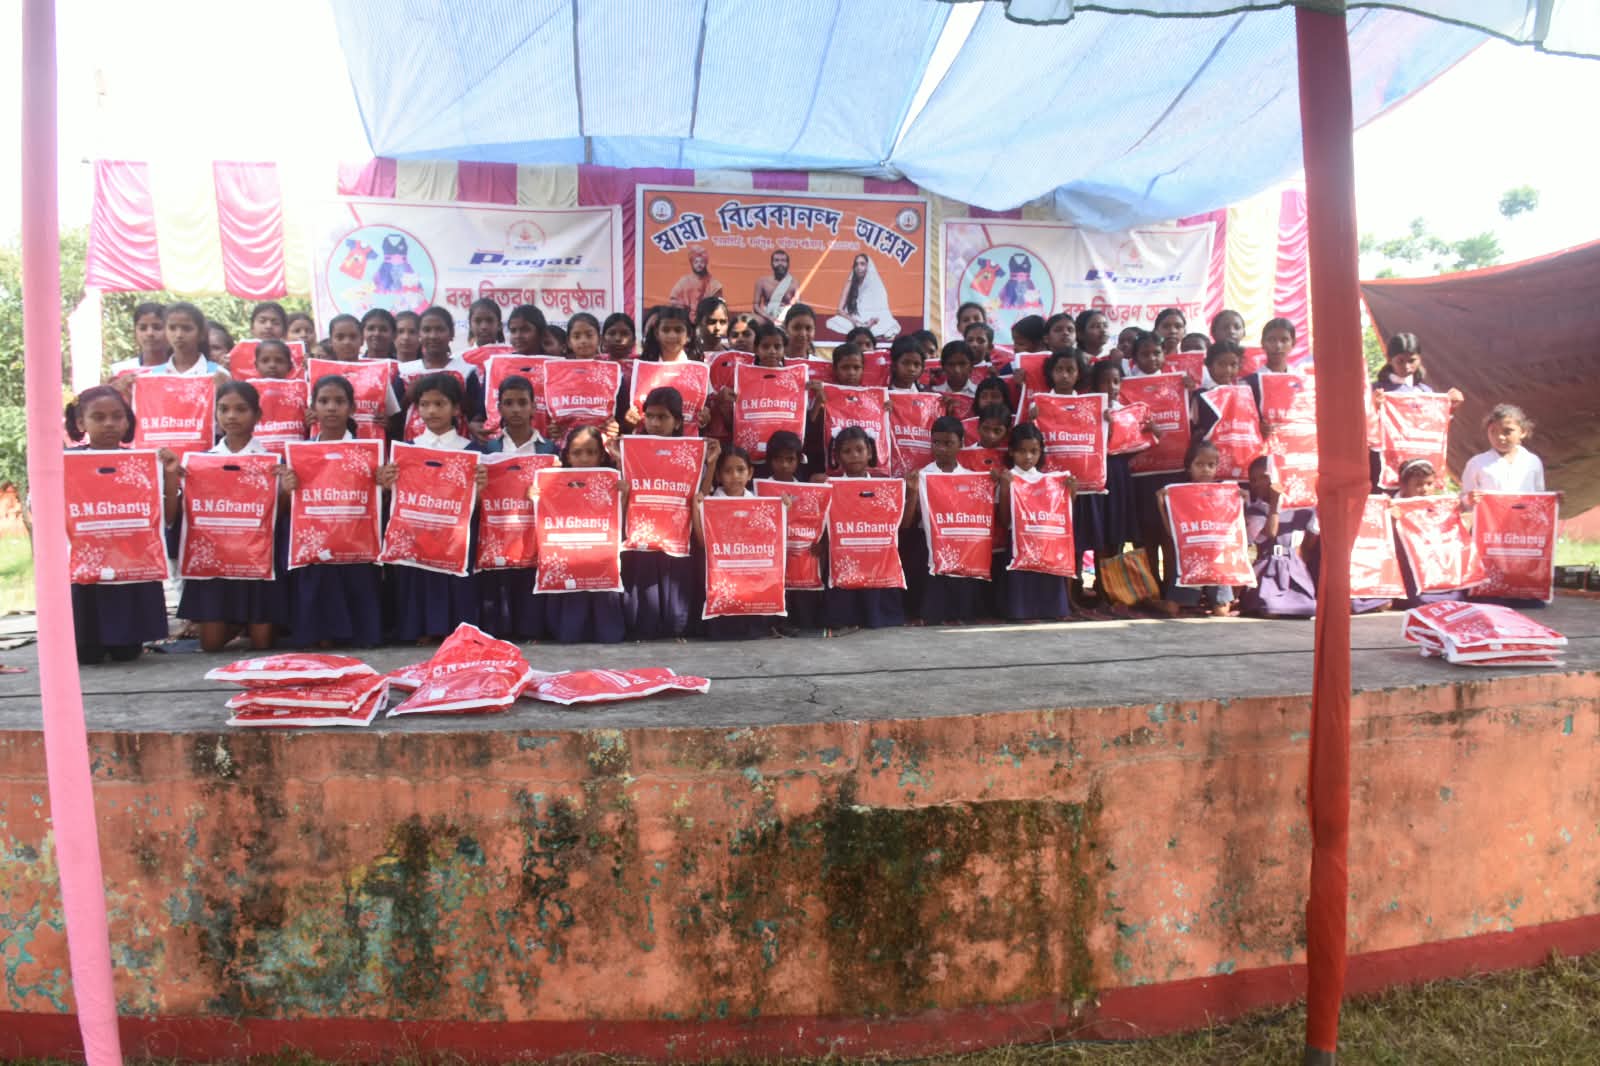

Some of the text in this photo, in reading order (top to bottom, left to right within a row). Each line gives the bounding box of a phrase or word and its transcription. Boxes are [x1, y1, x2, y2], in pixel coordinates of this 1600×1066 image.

[652, 200, 917, 265] স্বামী বিবেকানন্দ আশ্রম
[470, 252, 583, 268] Pragati
[541, 282, 605, 314] অনুষ্ঠান
[70, 501, 151, 518] B.N.Ghanty
[192, 498, 265, 517] B.N.Ghanty
